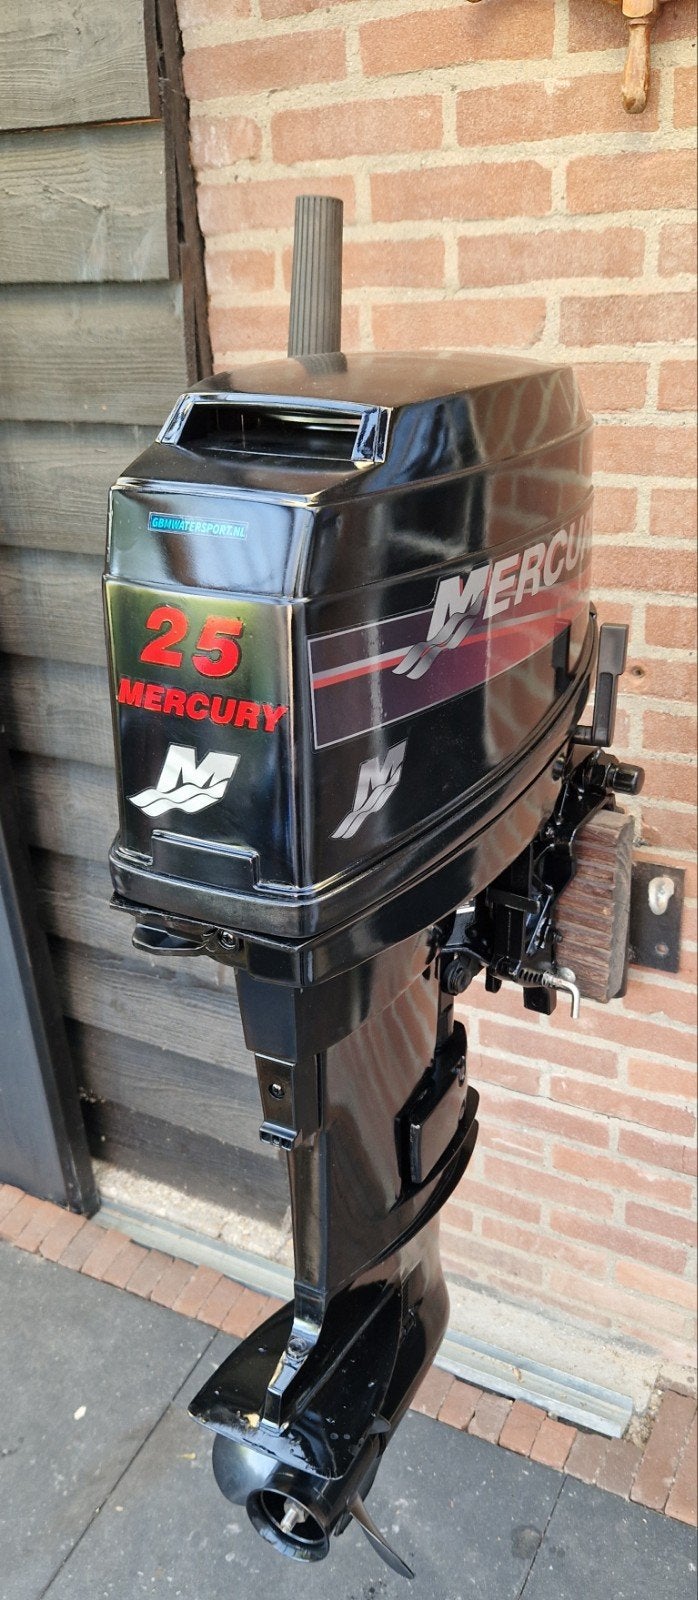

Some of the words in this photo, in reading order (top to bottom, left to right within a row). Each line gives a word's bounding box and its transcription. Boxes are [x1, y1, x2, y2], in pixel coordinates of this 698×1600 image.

[151, 517, 246, 538] GBMWATERSPORT.NL
[418, 514, 591, 652] MERCU
[139, 605, 244, 680] 25
[117, 677, 288, 733] MERCURY
[130, 744, 241, 815] M
